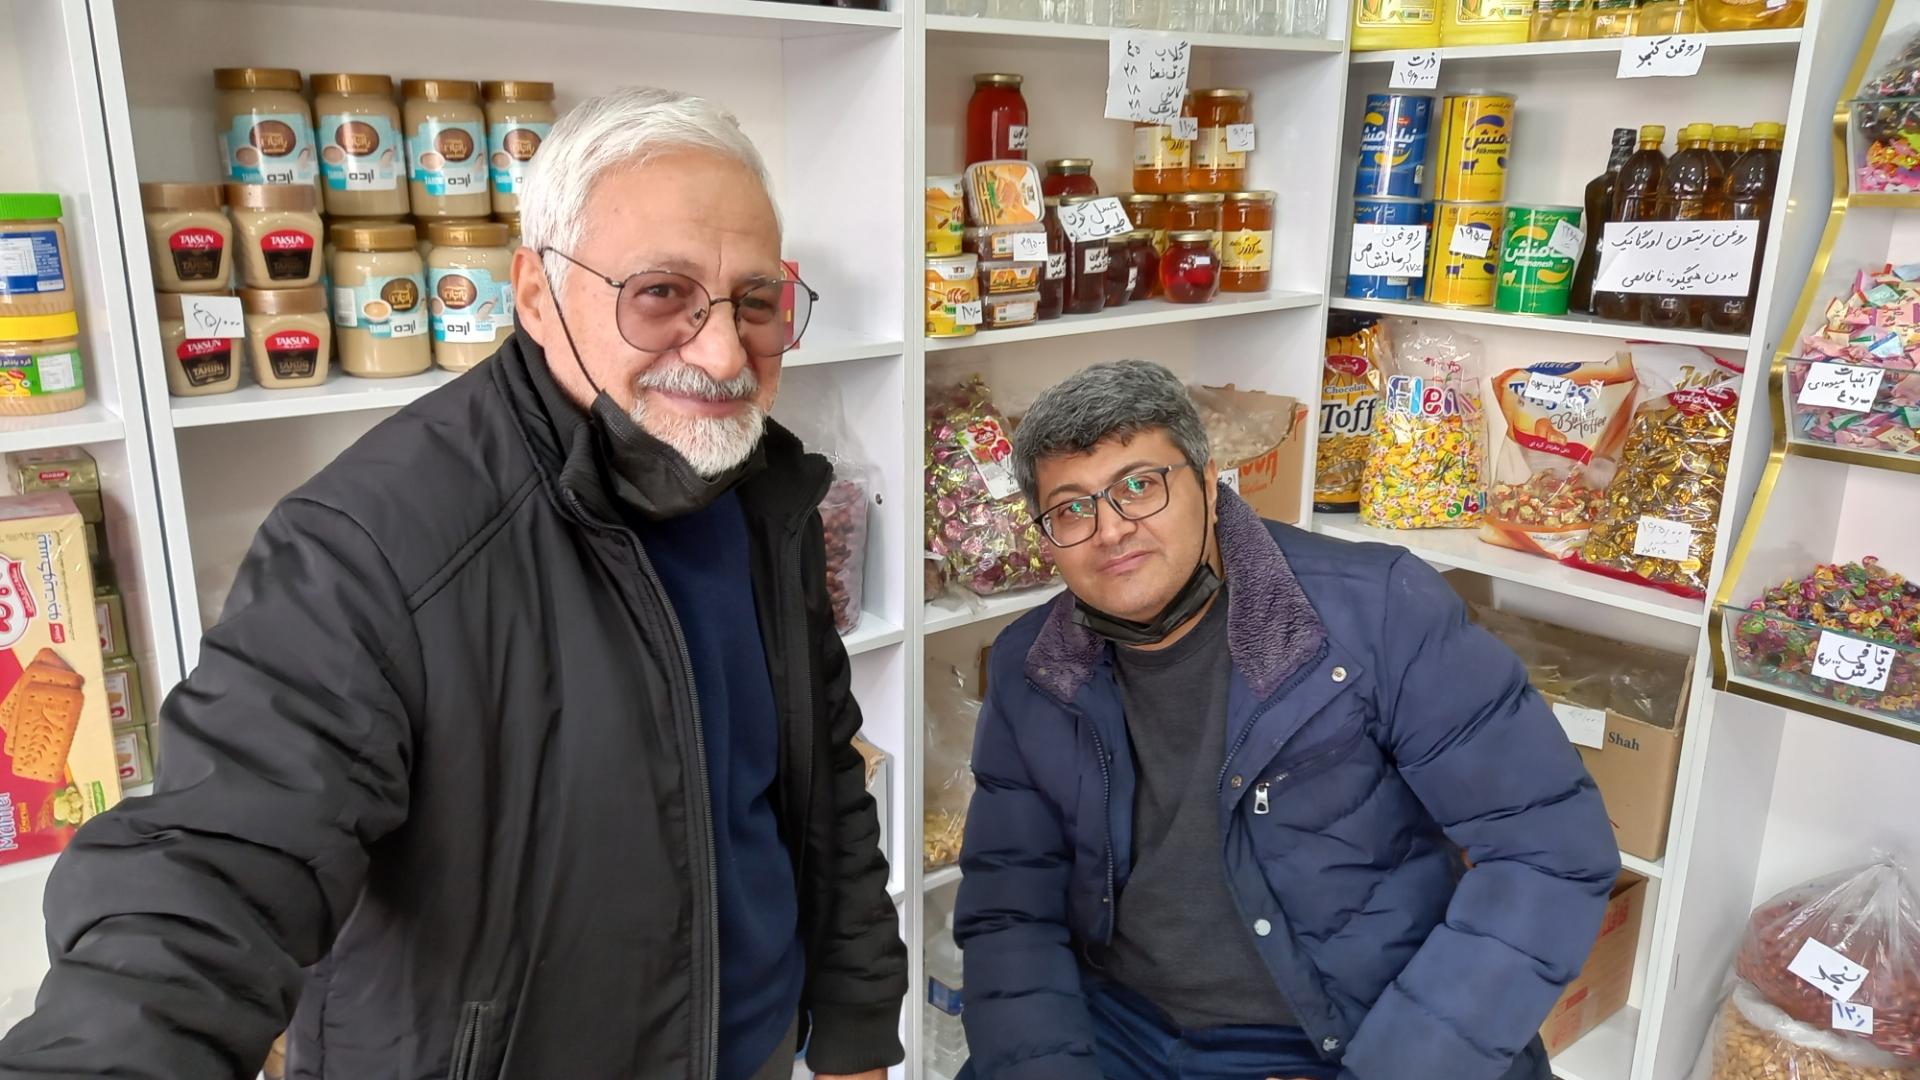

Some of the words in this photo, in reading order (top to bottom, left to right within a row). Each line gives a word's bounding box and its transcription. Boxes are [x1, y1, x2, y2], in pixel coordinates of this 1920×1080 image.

[1155, 41, 1188, 62] گلاب
[1408, 52, 1436, 69] ذرت
[179, 234, 214, 245] TAKSUN
[270, 235, 304, 245] TAKSUN
[1611, 226, 1664, 251] اورگانیک
[1665, 229, 1712, 250] زیتون
[1712, 225, 1748, 247] روغن
[1621, 269, 1665, 288] ناخالصی
[1704, 271, 1739, 284] بدون
[186, 339, 222, 353] TAKSUN
[275, 336, 310, 346] TAKSUN
[1834, 367, 1882, 388] آبنبات
[1324, 383, 1368, 394] Chocolate
[1608, 731, 1640, 751] Shah
